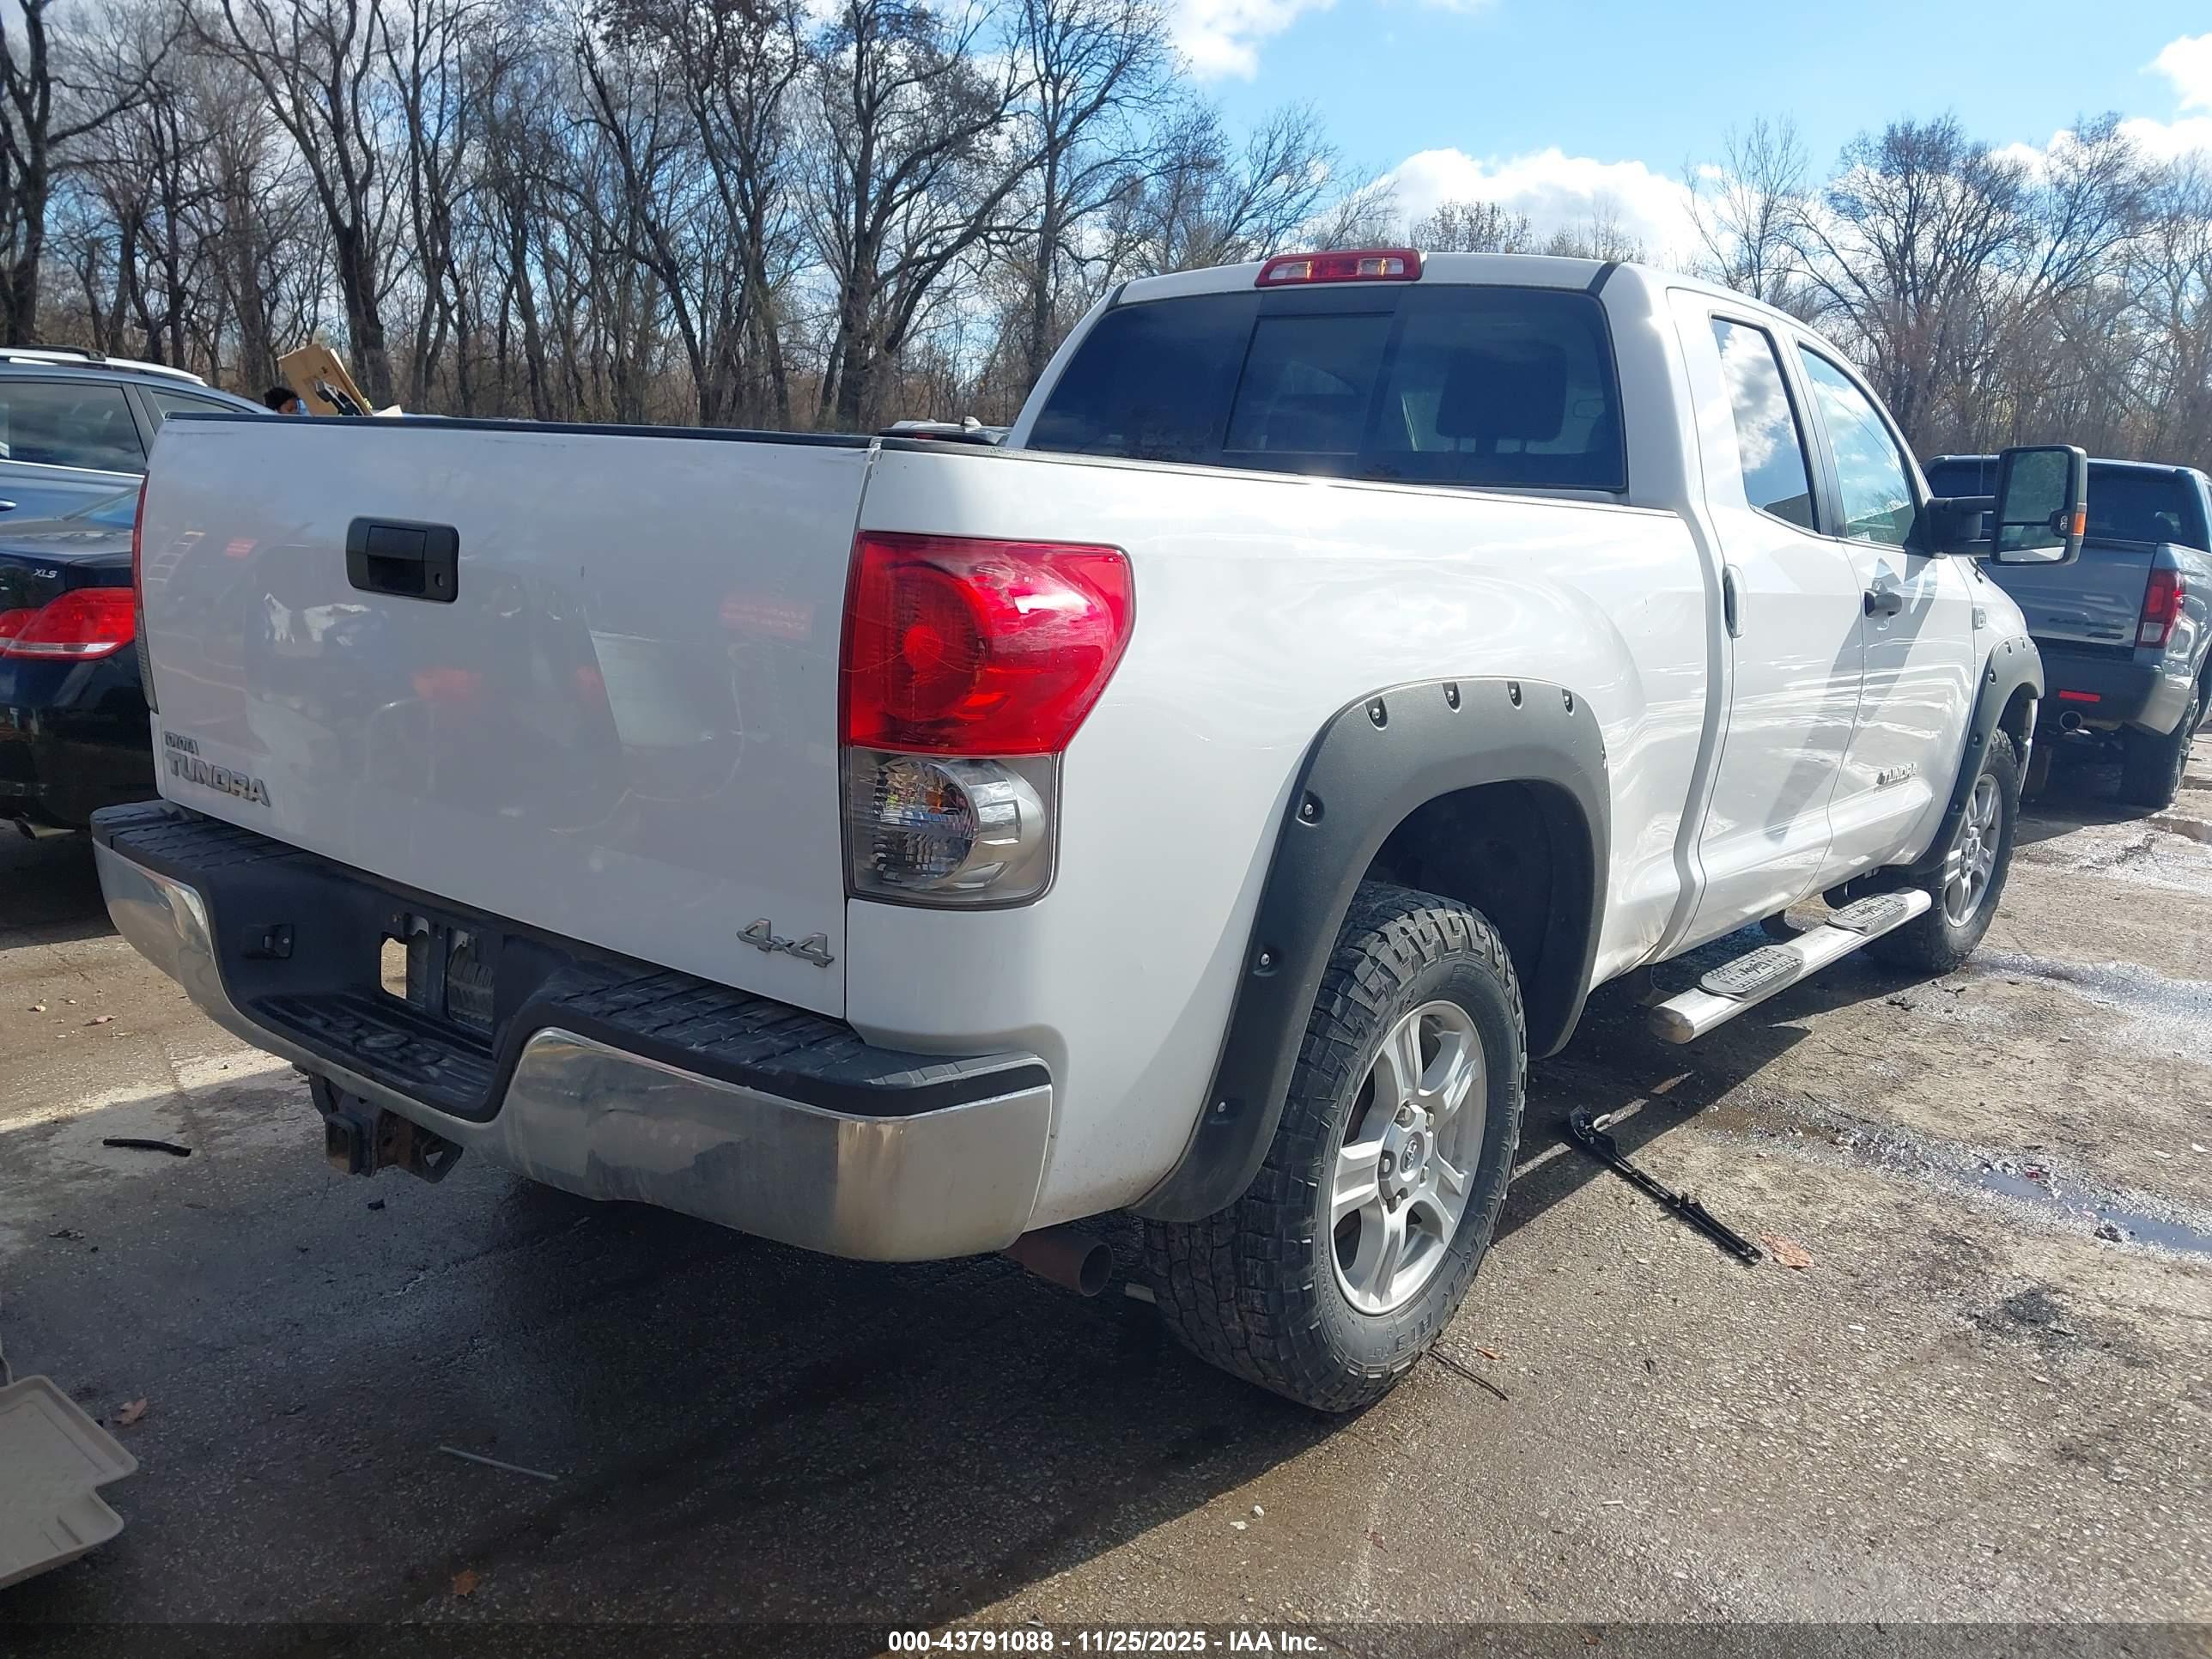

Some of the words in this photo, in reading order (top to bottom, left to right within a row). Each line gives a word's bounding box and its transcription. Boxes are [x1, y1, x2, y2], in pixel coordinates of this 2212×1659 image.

[33, 568, 58, 579] XLS
[166, 750, 271, 807] TUNDRA
[1880, 763, 1917, 785] TUNDRA
